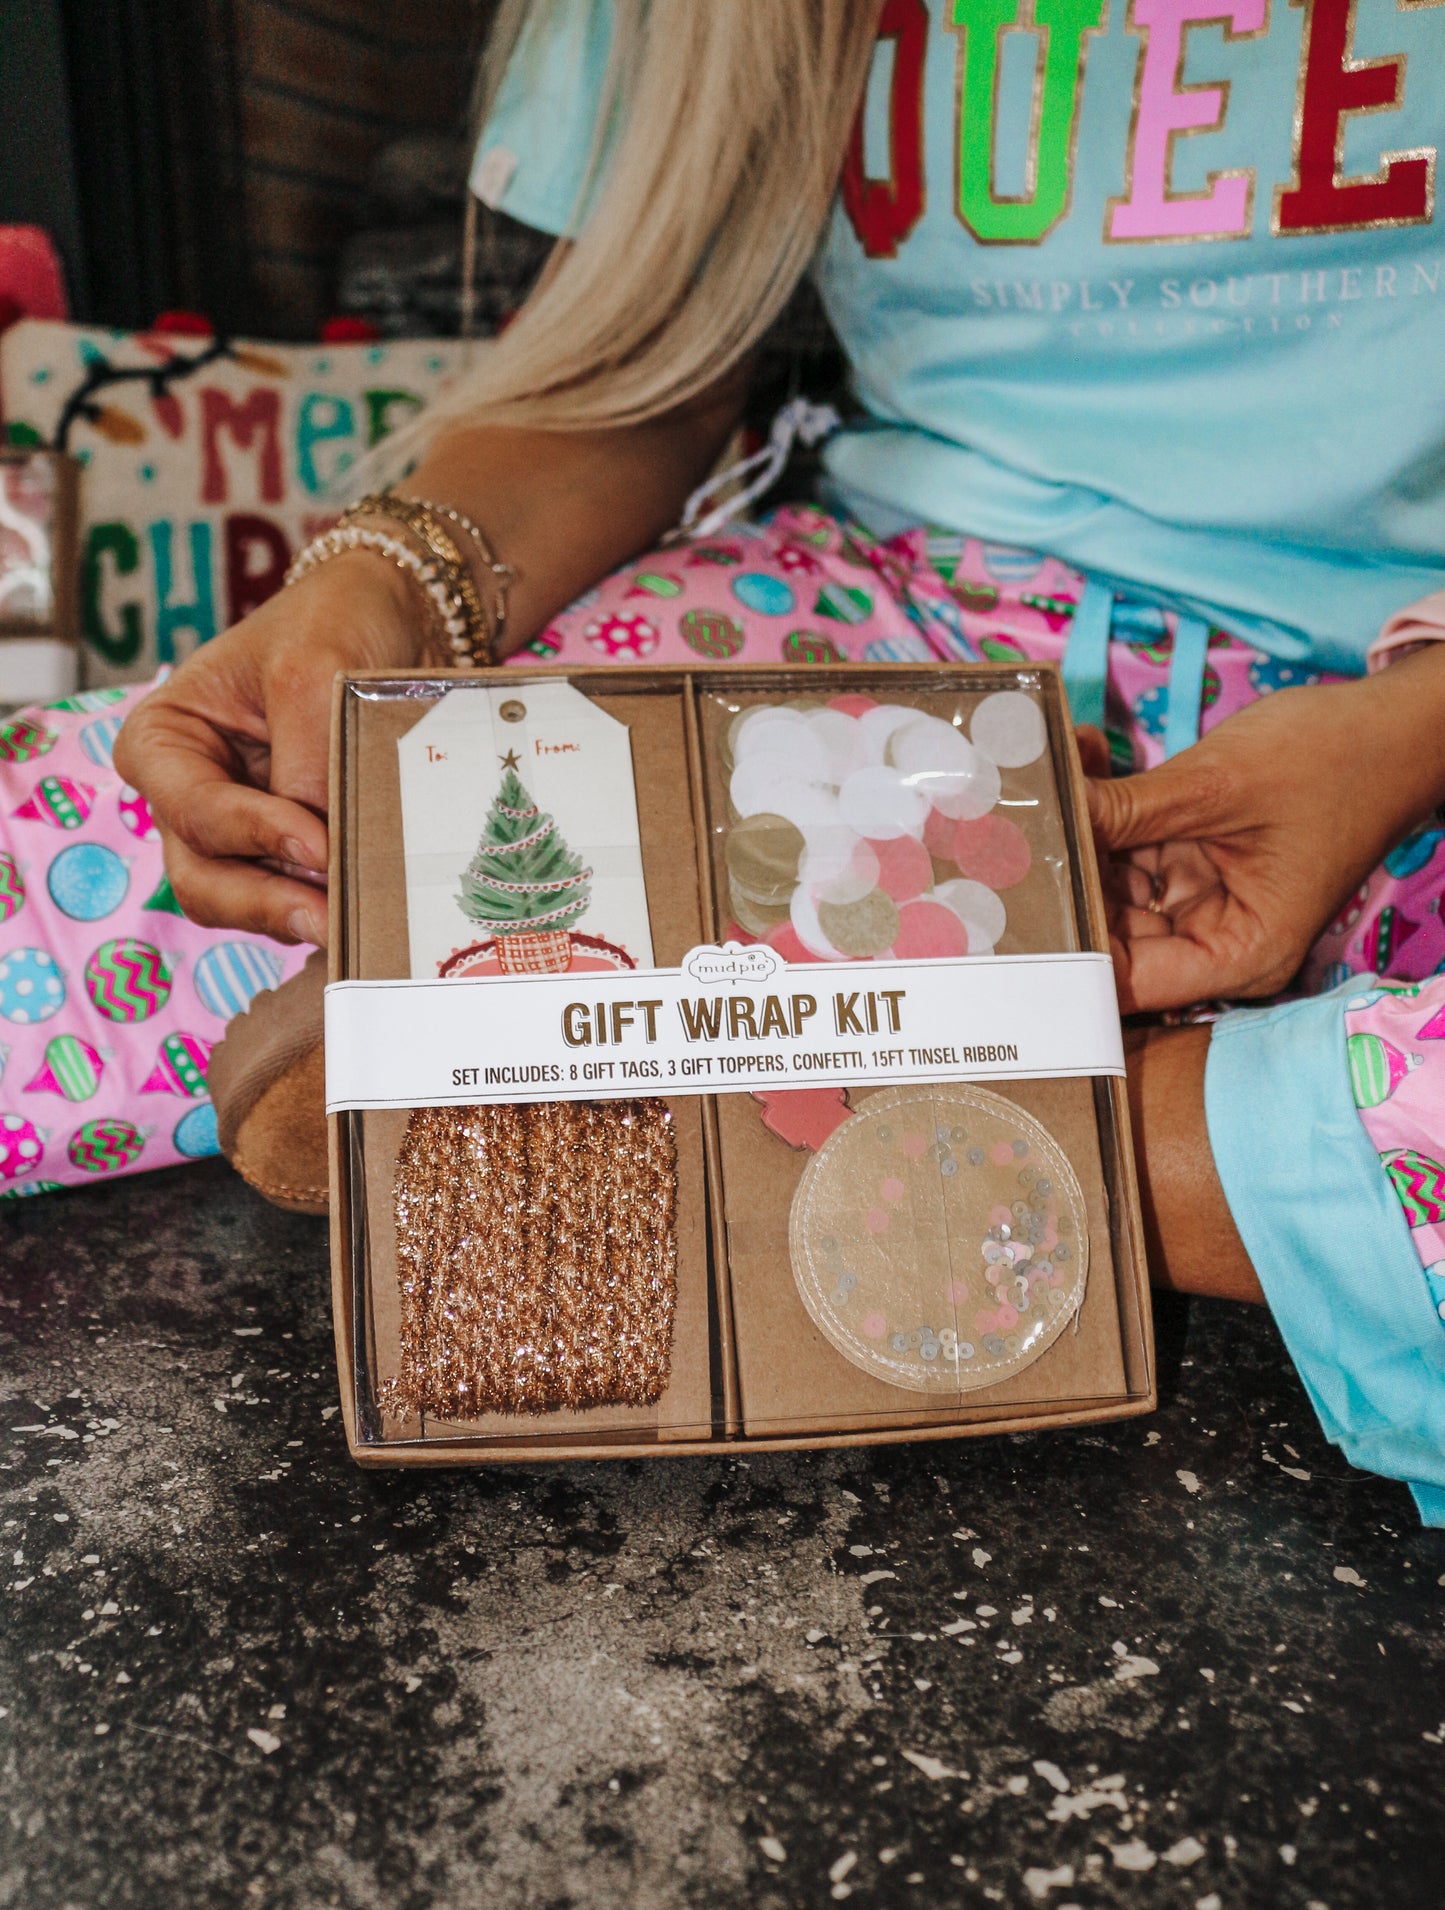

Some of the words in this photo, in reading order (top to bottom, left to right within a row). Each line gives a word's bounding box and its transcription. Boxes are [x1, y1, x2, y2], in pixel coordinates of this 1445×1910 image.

[970, 277, 1135, 312] SIMPLY
[1158, 260, 1441, 310] SOUTHERN
[425, 745, 448, 763] To:
[535, 738, 581, 756] From:
[560, 999, 664, 1049] GIFT
[676, 994, 817, 1043] WRAP
[832, 990, 906, 1037] KIT
[452, 1068, 480, 1086] SET
[484, 1064, 565, 1084] INCLUDES:
[569, 1064, 578, 1081] 8
[582, 1062, 615, 1080] GIFT
[619, 1059, 663, 1079] TAGS,
[667, 1059, 677, 1076] 3
[681, 1057, 713, 1076] GIFT
[717, 1054, 789, 1073] TOPPERS,
[792, 1051, 867, 1070] CONFETTI,
[871, 1049, 905, 1067] 15FT
[908, 1047, 960, 1066] TINSEL
[963, 1044, 1019, 1064] RIBBON
